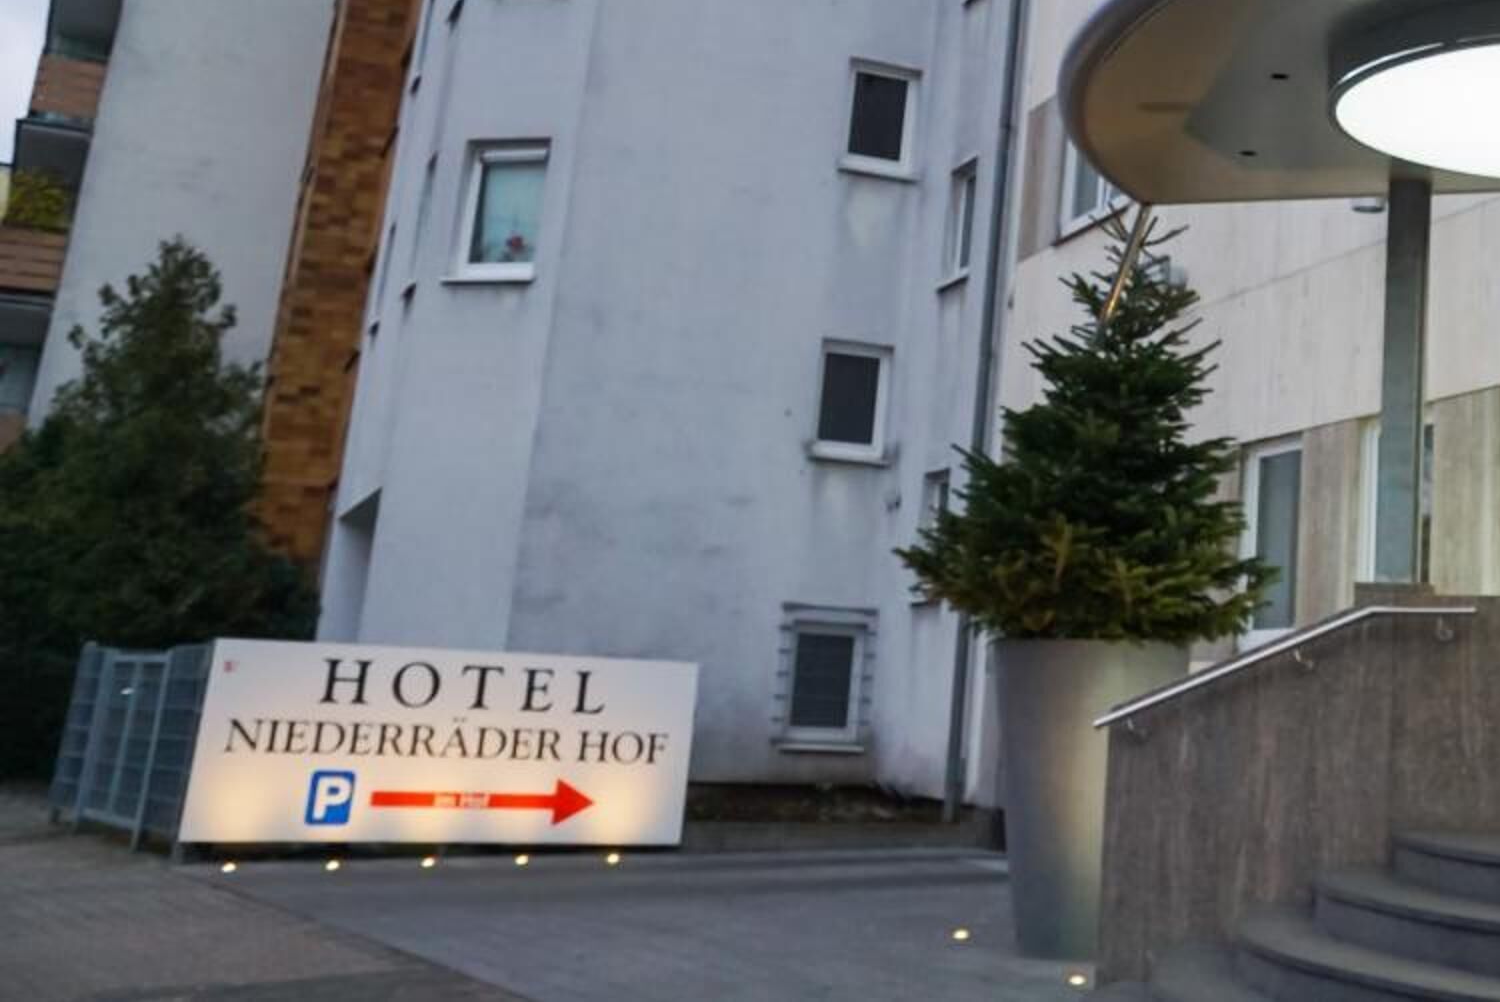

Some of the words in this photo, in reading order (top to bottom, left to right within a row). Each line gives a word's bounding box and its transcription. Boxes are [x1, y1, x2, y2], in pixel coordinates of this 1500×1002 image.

[318, 657, 606, 715] HOTEL
[223, 716, 562, 762] NIEDERRÄDER
[576, 730, 669, 766] HOF
[312, 775, 352, 821] P
